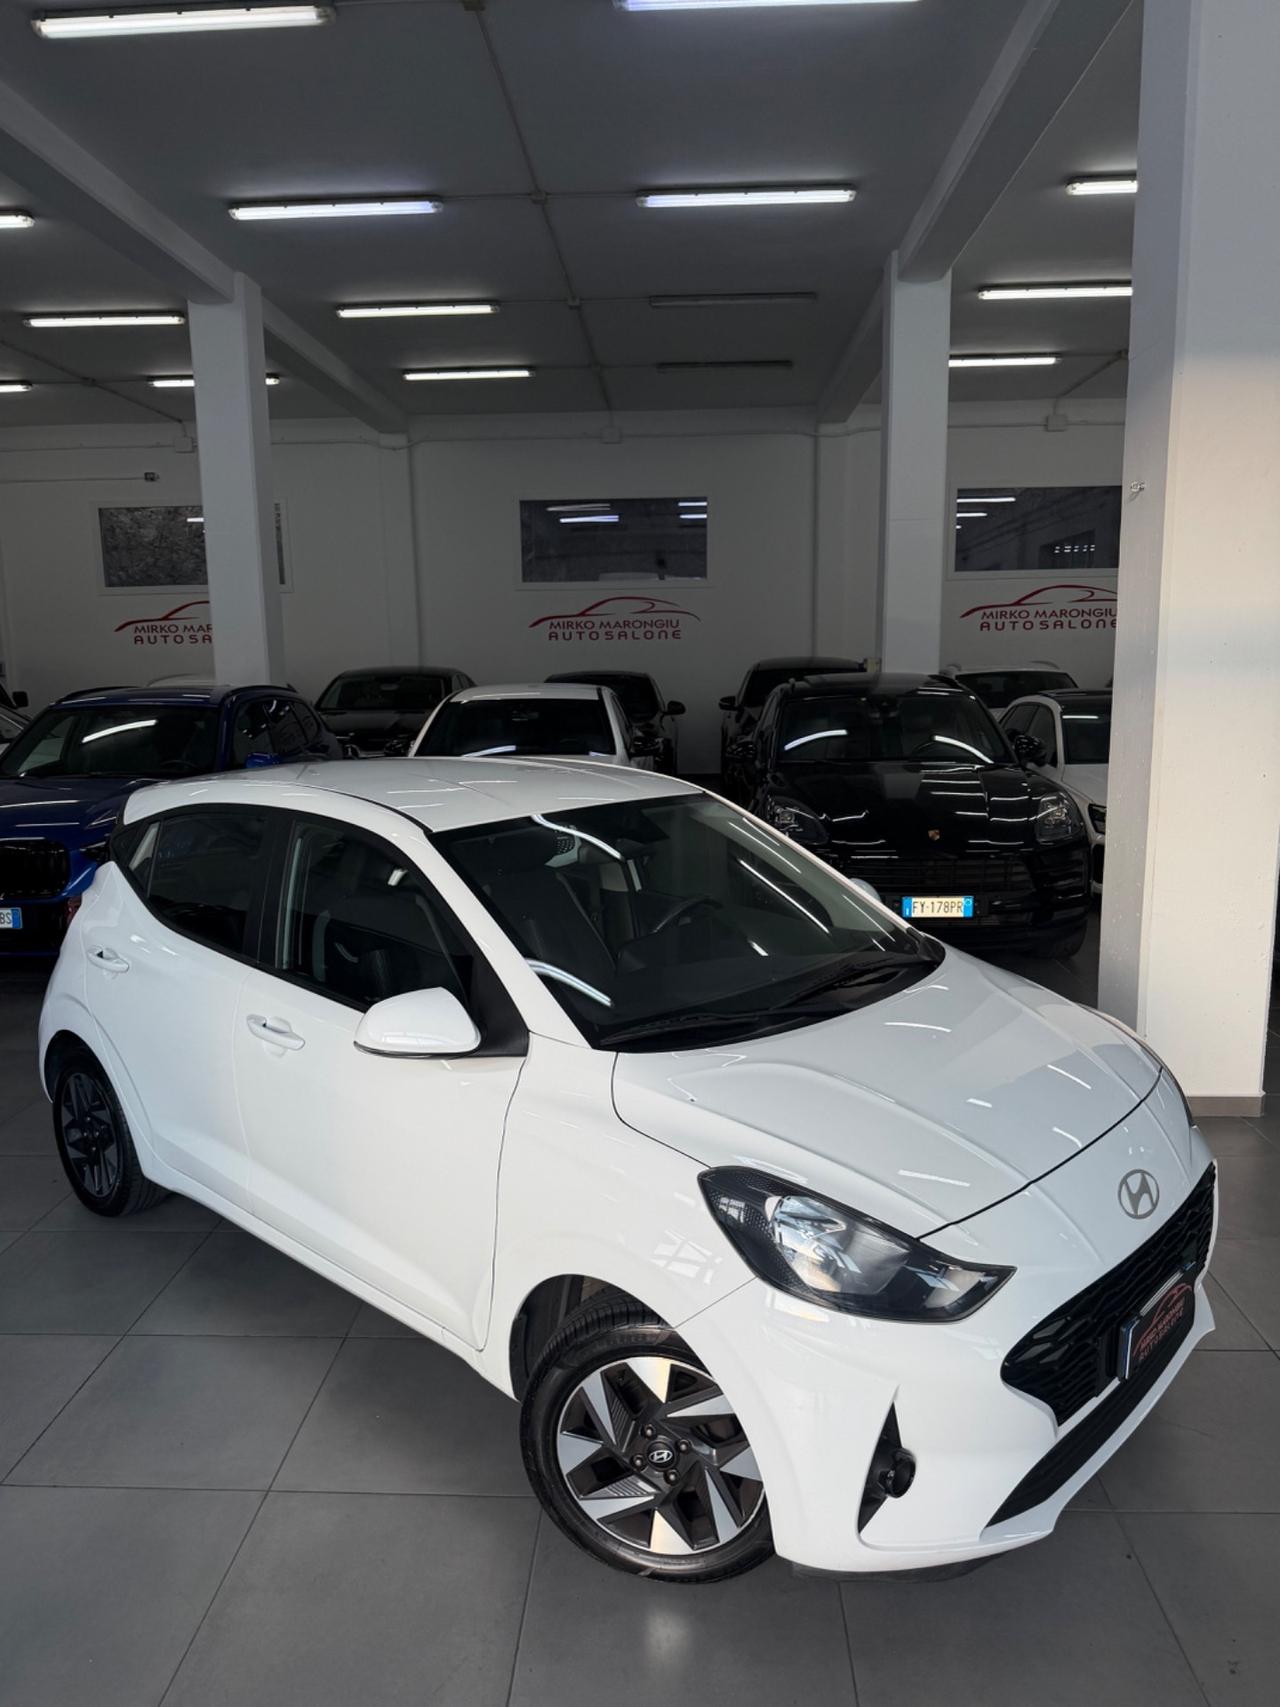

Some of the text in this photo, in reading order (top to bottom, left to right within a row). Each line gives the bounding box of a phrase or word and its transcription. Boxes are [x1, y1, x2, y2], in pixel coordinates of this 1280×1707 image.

[983, 607, 1117, 620] MIRKO MARONGIU
[133, 624, 179, 634] MIRKO
[549, 618, 680, 630] MIRKO MARONGIU
[548, 629, 681, 641] AUTOSALONE
